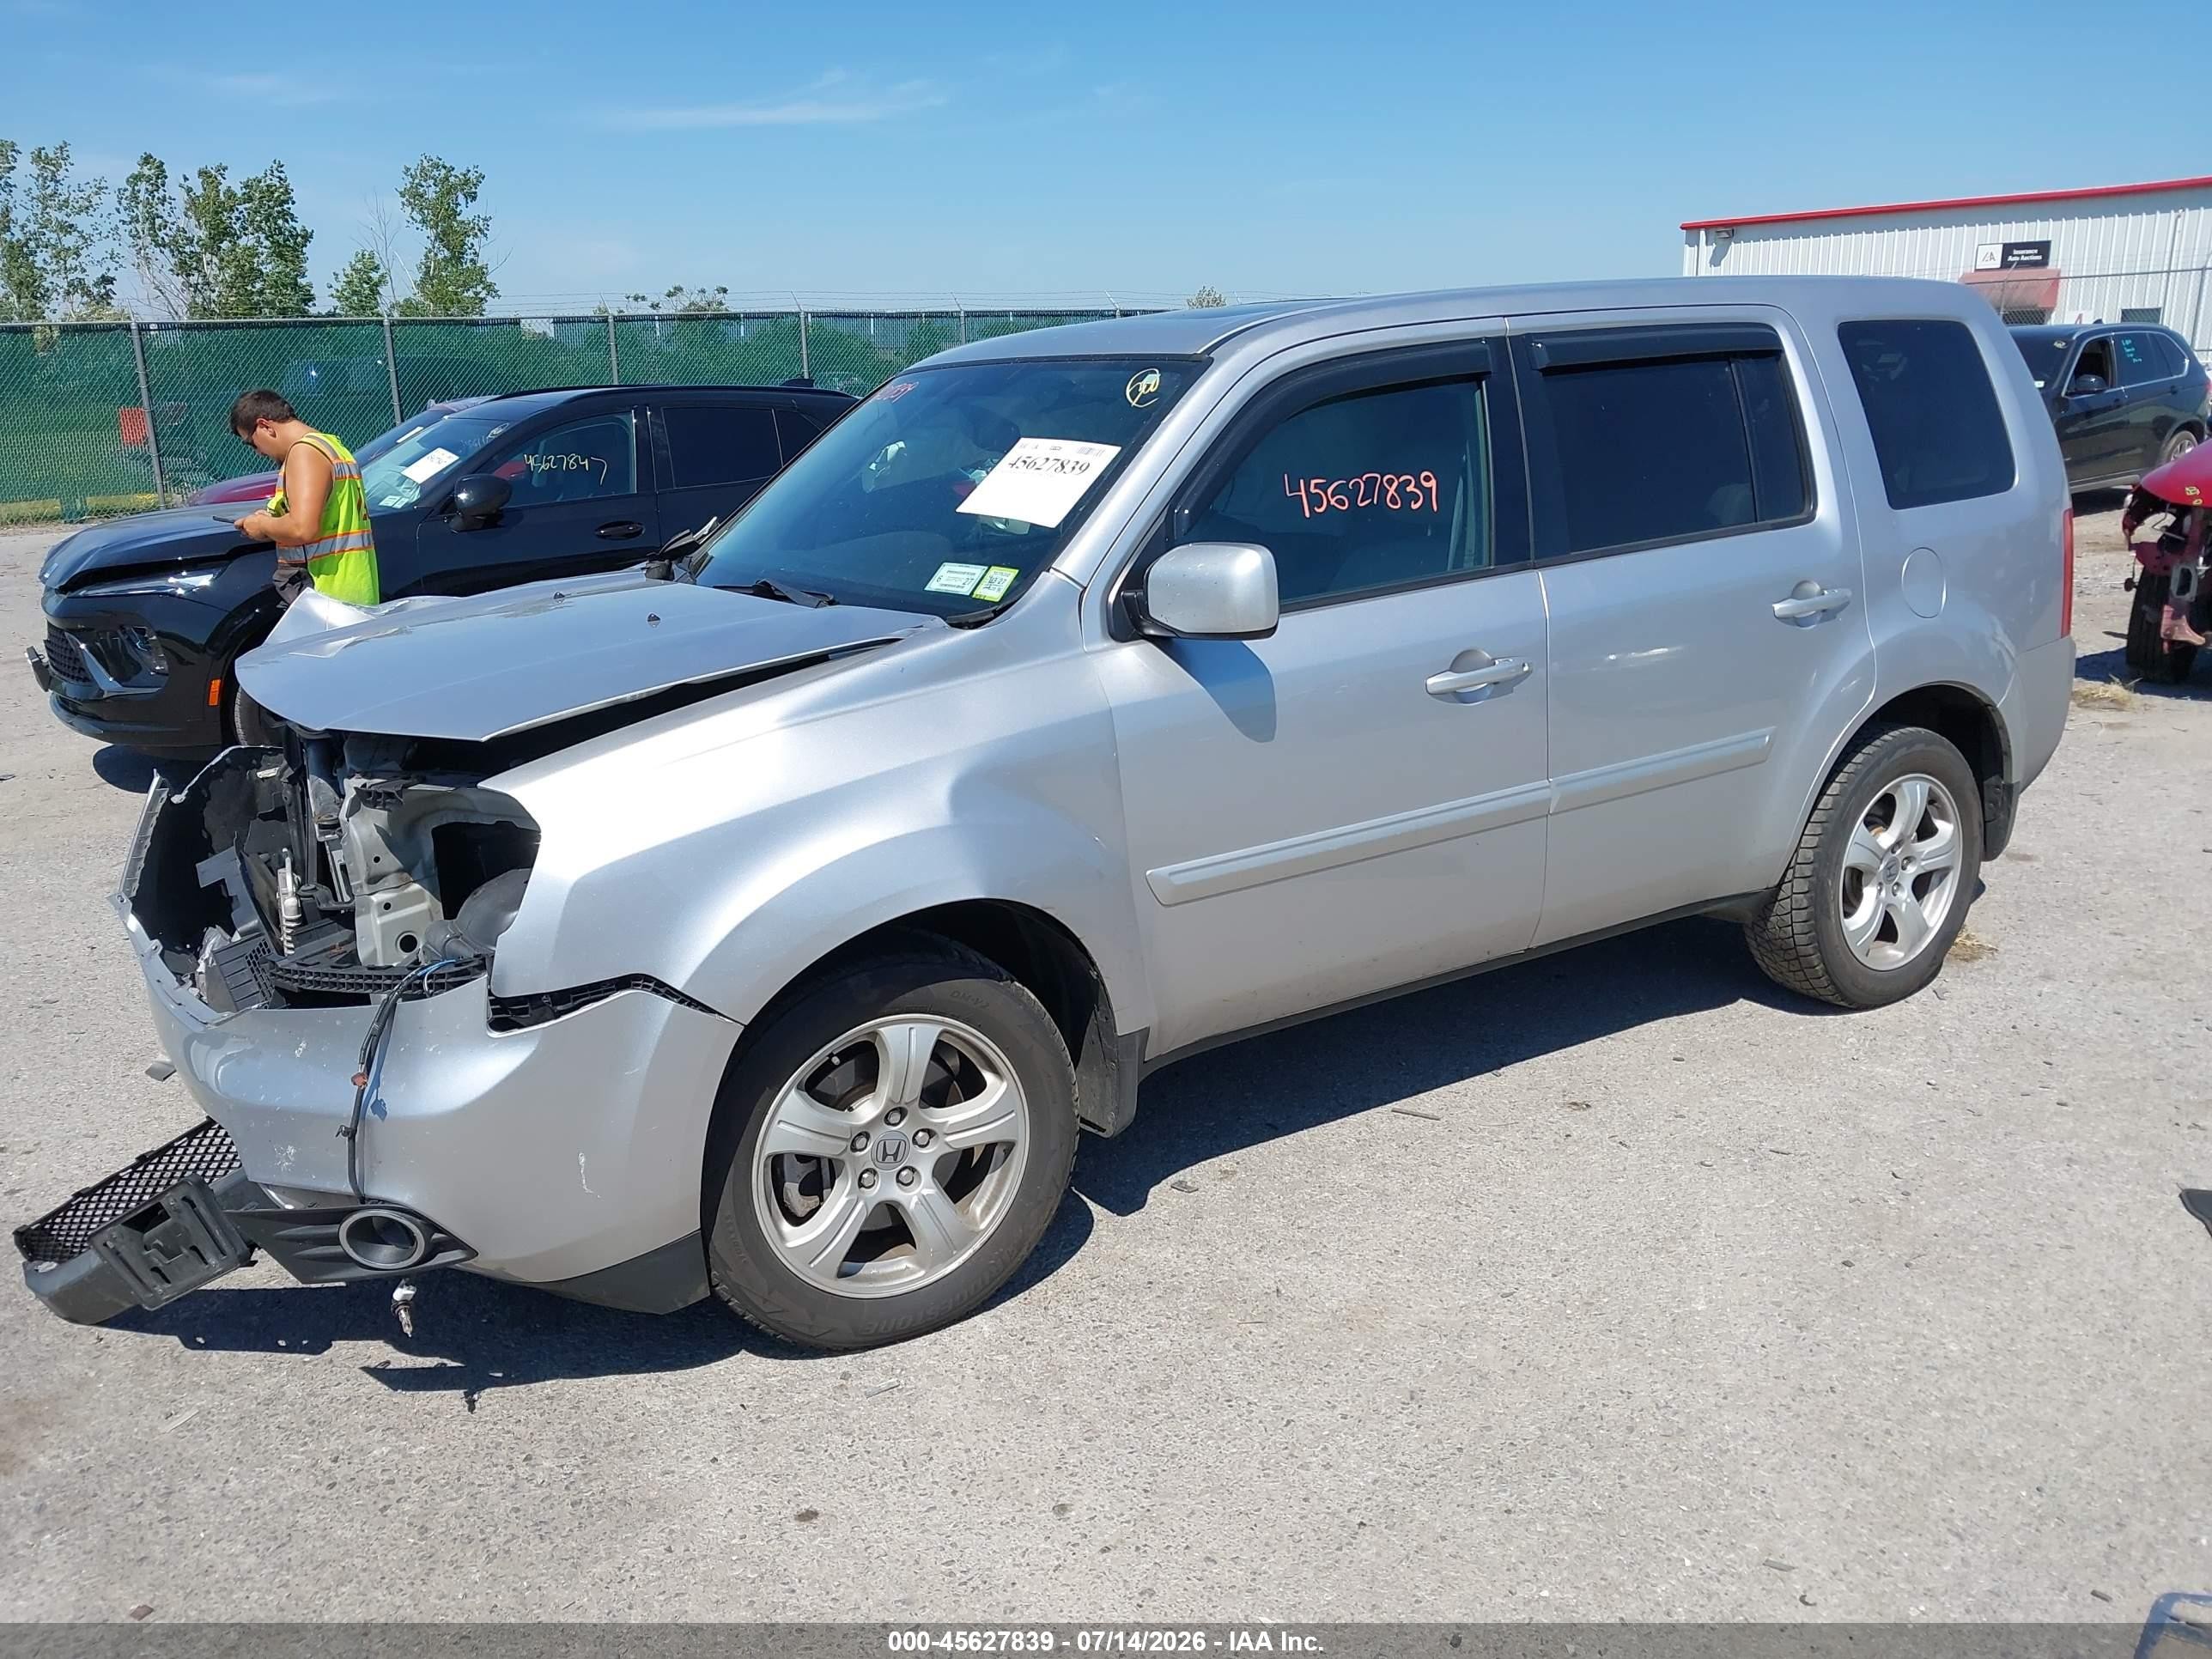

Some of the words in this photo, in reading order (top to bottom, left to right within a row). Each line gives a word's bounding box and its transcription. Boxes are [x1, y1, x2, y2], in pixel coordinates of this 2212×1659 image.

[524, 453, 607, 485] 45627847
[1007, 455, 1091, 475] 45627839
[1284, 471, 1438, 519] 45627839
